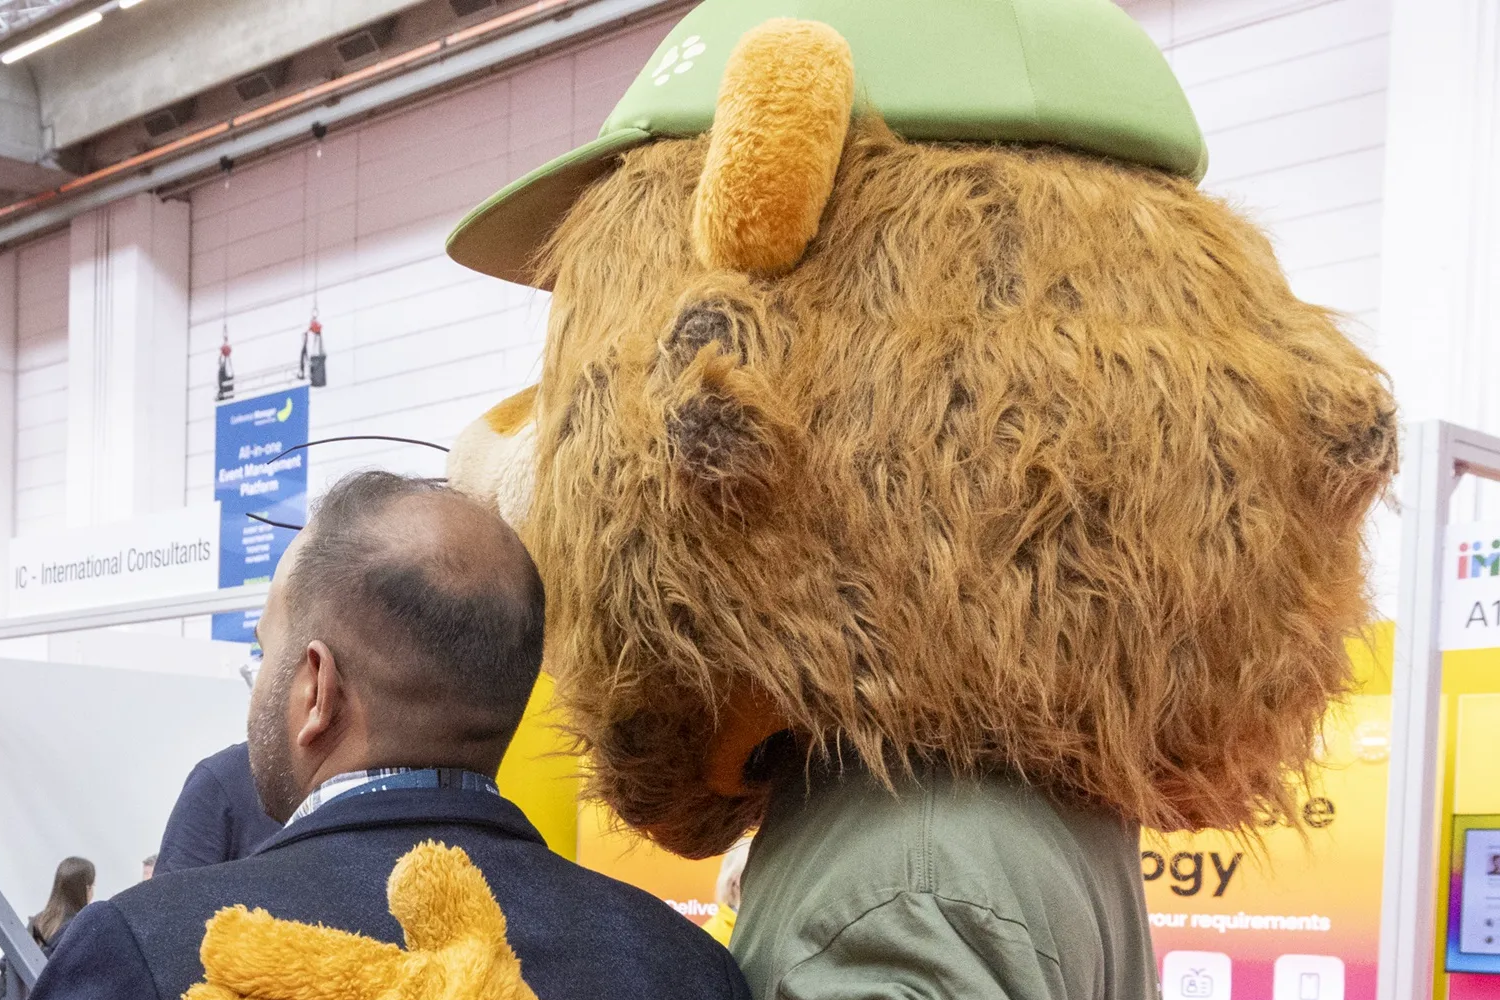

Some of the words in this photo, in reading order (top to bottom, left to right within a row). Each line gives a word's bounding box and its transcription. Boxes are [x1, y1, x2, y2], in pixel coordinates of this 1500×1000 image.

[239, 441, 282, 460] All-in-one
[219, 466, 243, 483] Event
[244, 454, 301, 477] Management
[240, 479, 279, 497] Platform
[15, 565, 28, 589] IC
[41, 551, 123, 585] International
[127, 537, 211, 573] Consultants
[1191, 911, 1332, 933] requirements
